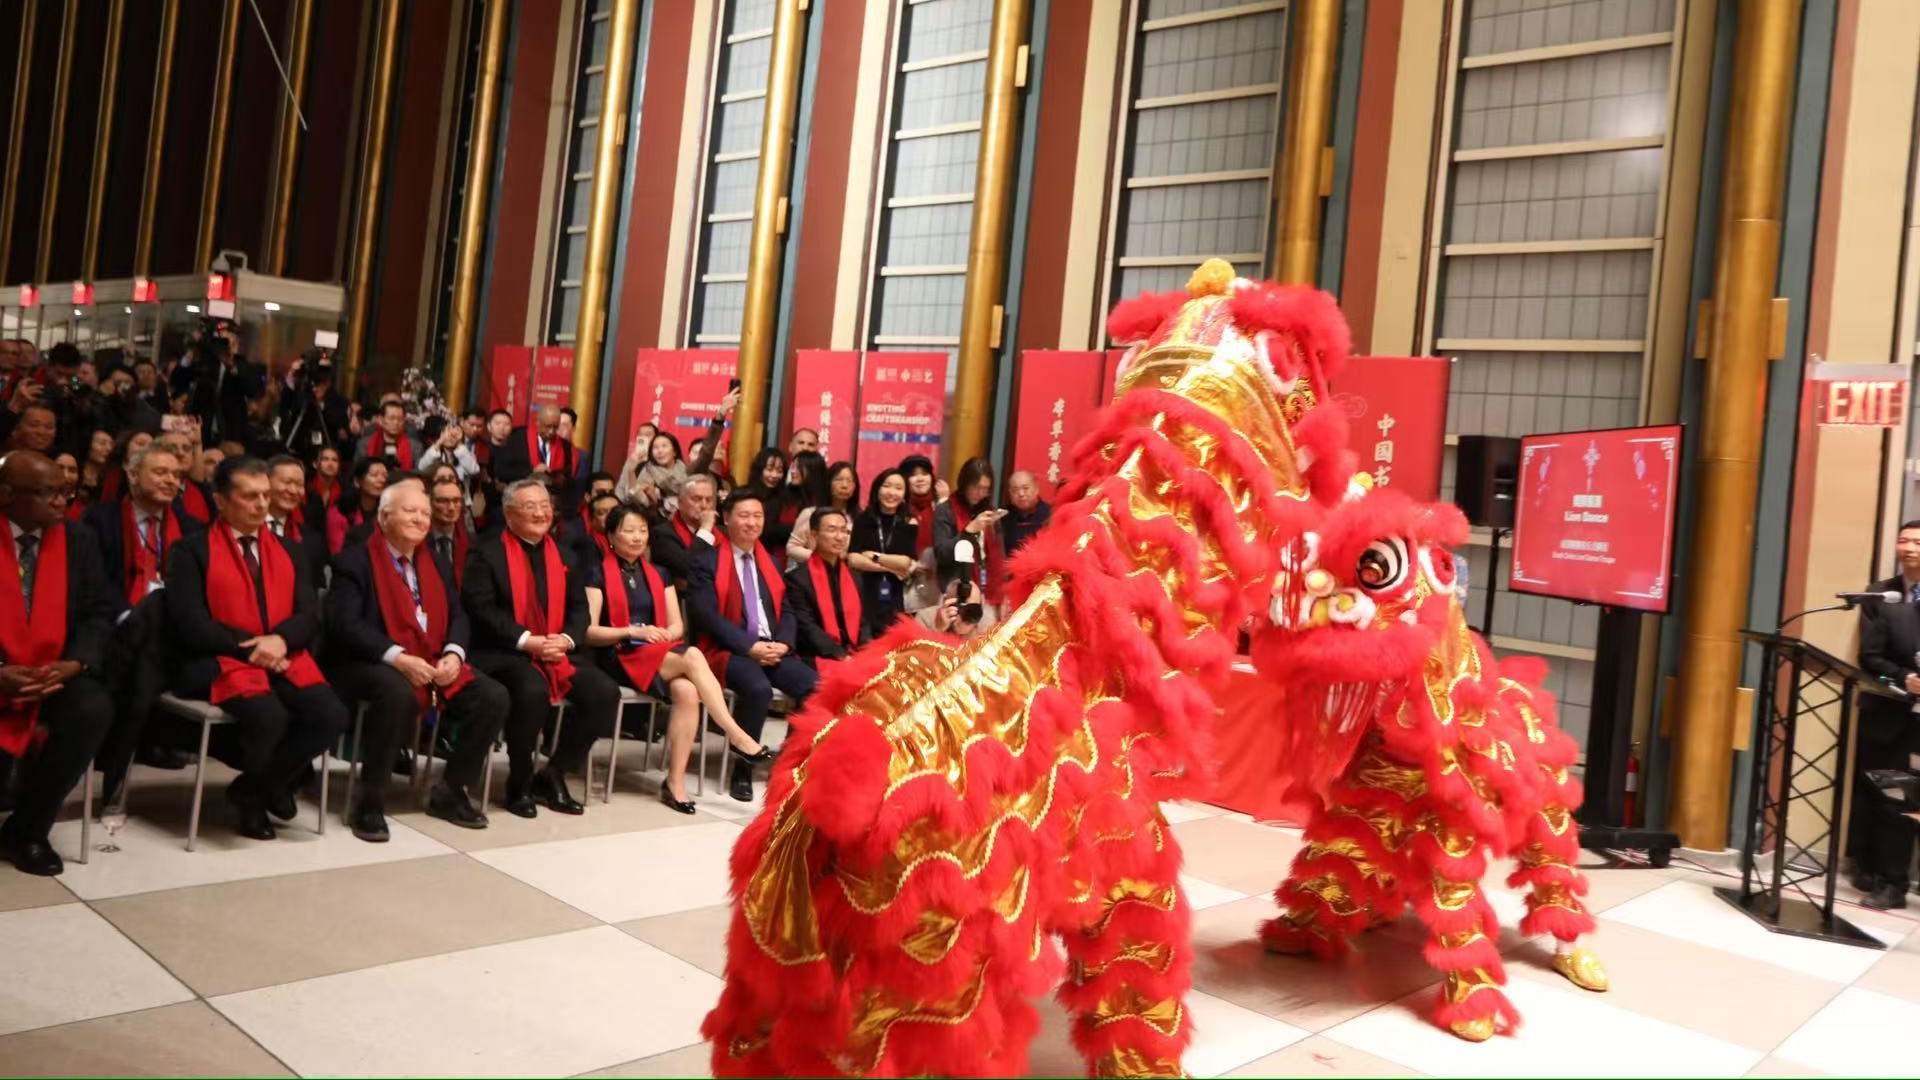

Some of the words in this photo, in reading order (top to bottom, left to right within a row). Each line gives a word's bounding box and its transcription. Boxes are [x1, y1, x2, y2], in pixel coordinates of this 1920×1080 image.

[1828, 381, 1896, 424] EXIT
[1564, 511, 1582, 522] Lion
[1583, 511, 1609, 523] Dance
